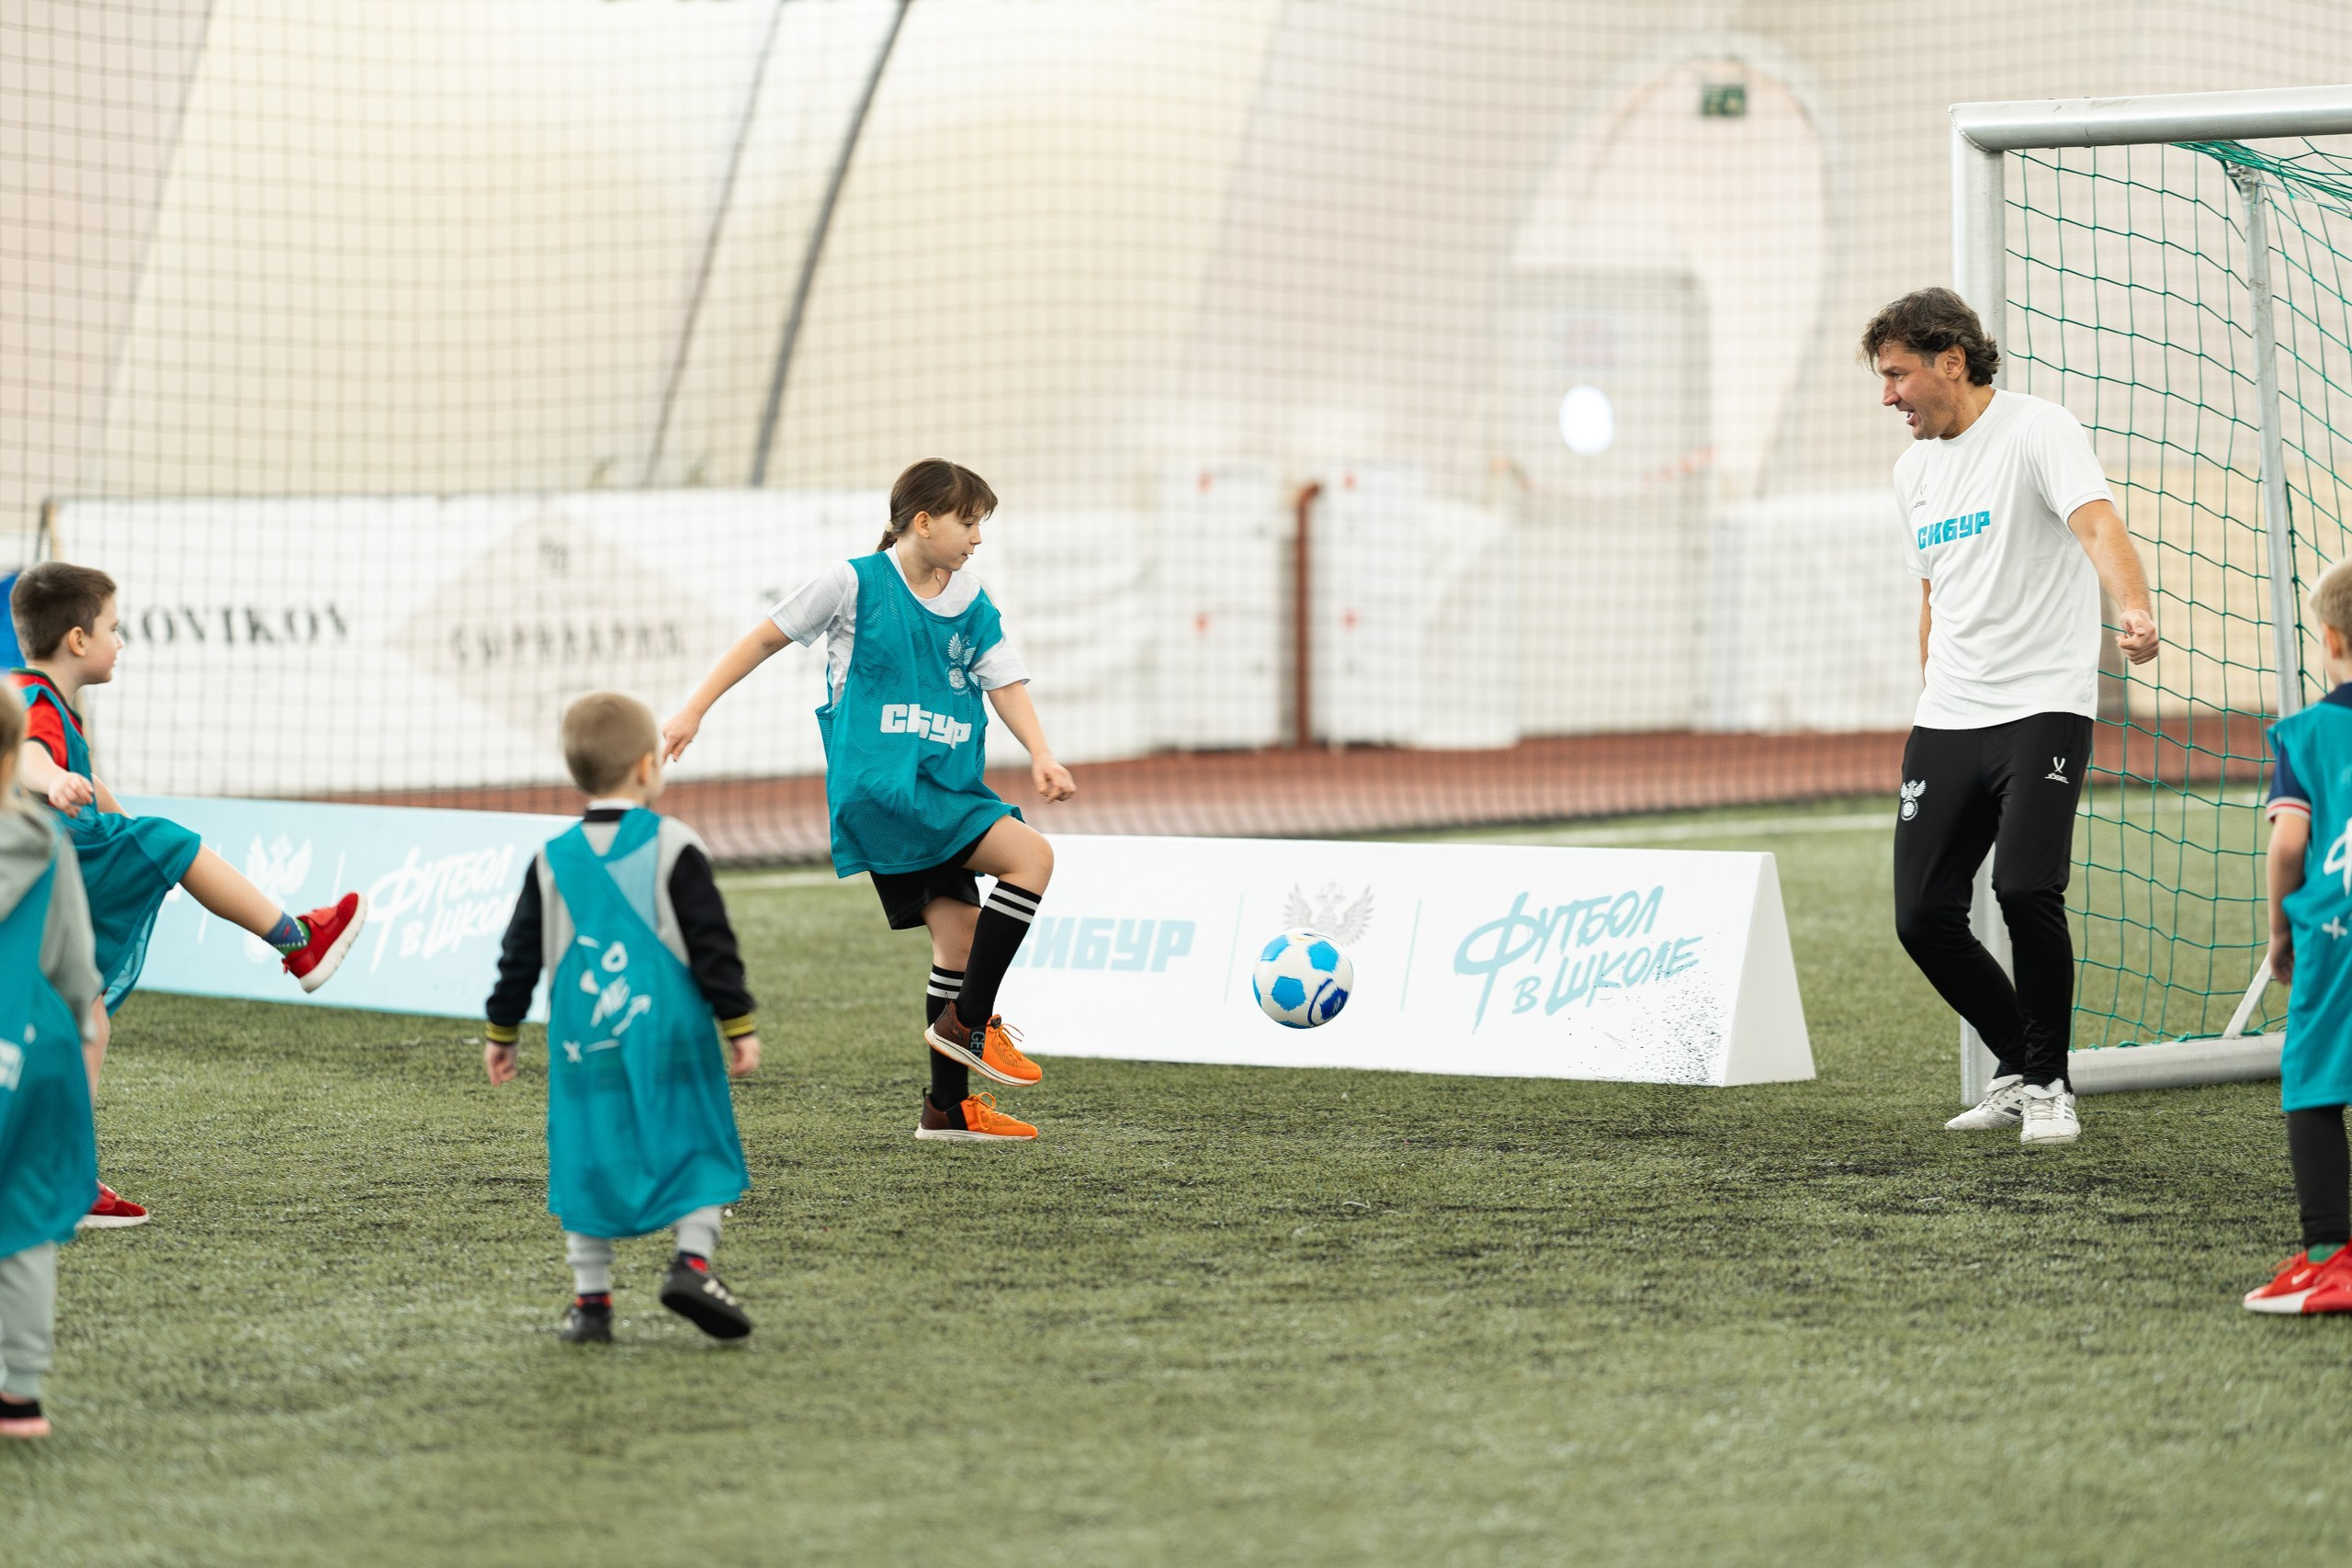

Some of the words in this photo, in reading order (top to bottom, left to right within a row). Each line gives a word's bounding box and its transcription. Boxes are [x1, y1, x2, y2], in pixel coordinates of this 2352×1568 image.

[1917, 511, 1990, 550] СИБУР
[366, 845, 514, 976] ФУТБОЛ
[1453, 885, 1664, 1035] ФУТБОЛ
[1544, 935, 1703, 1016] ШКОЛЕ
